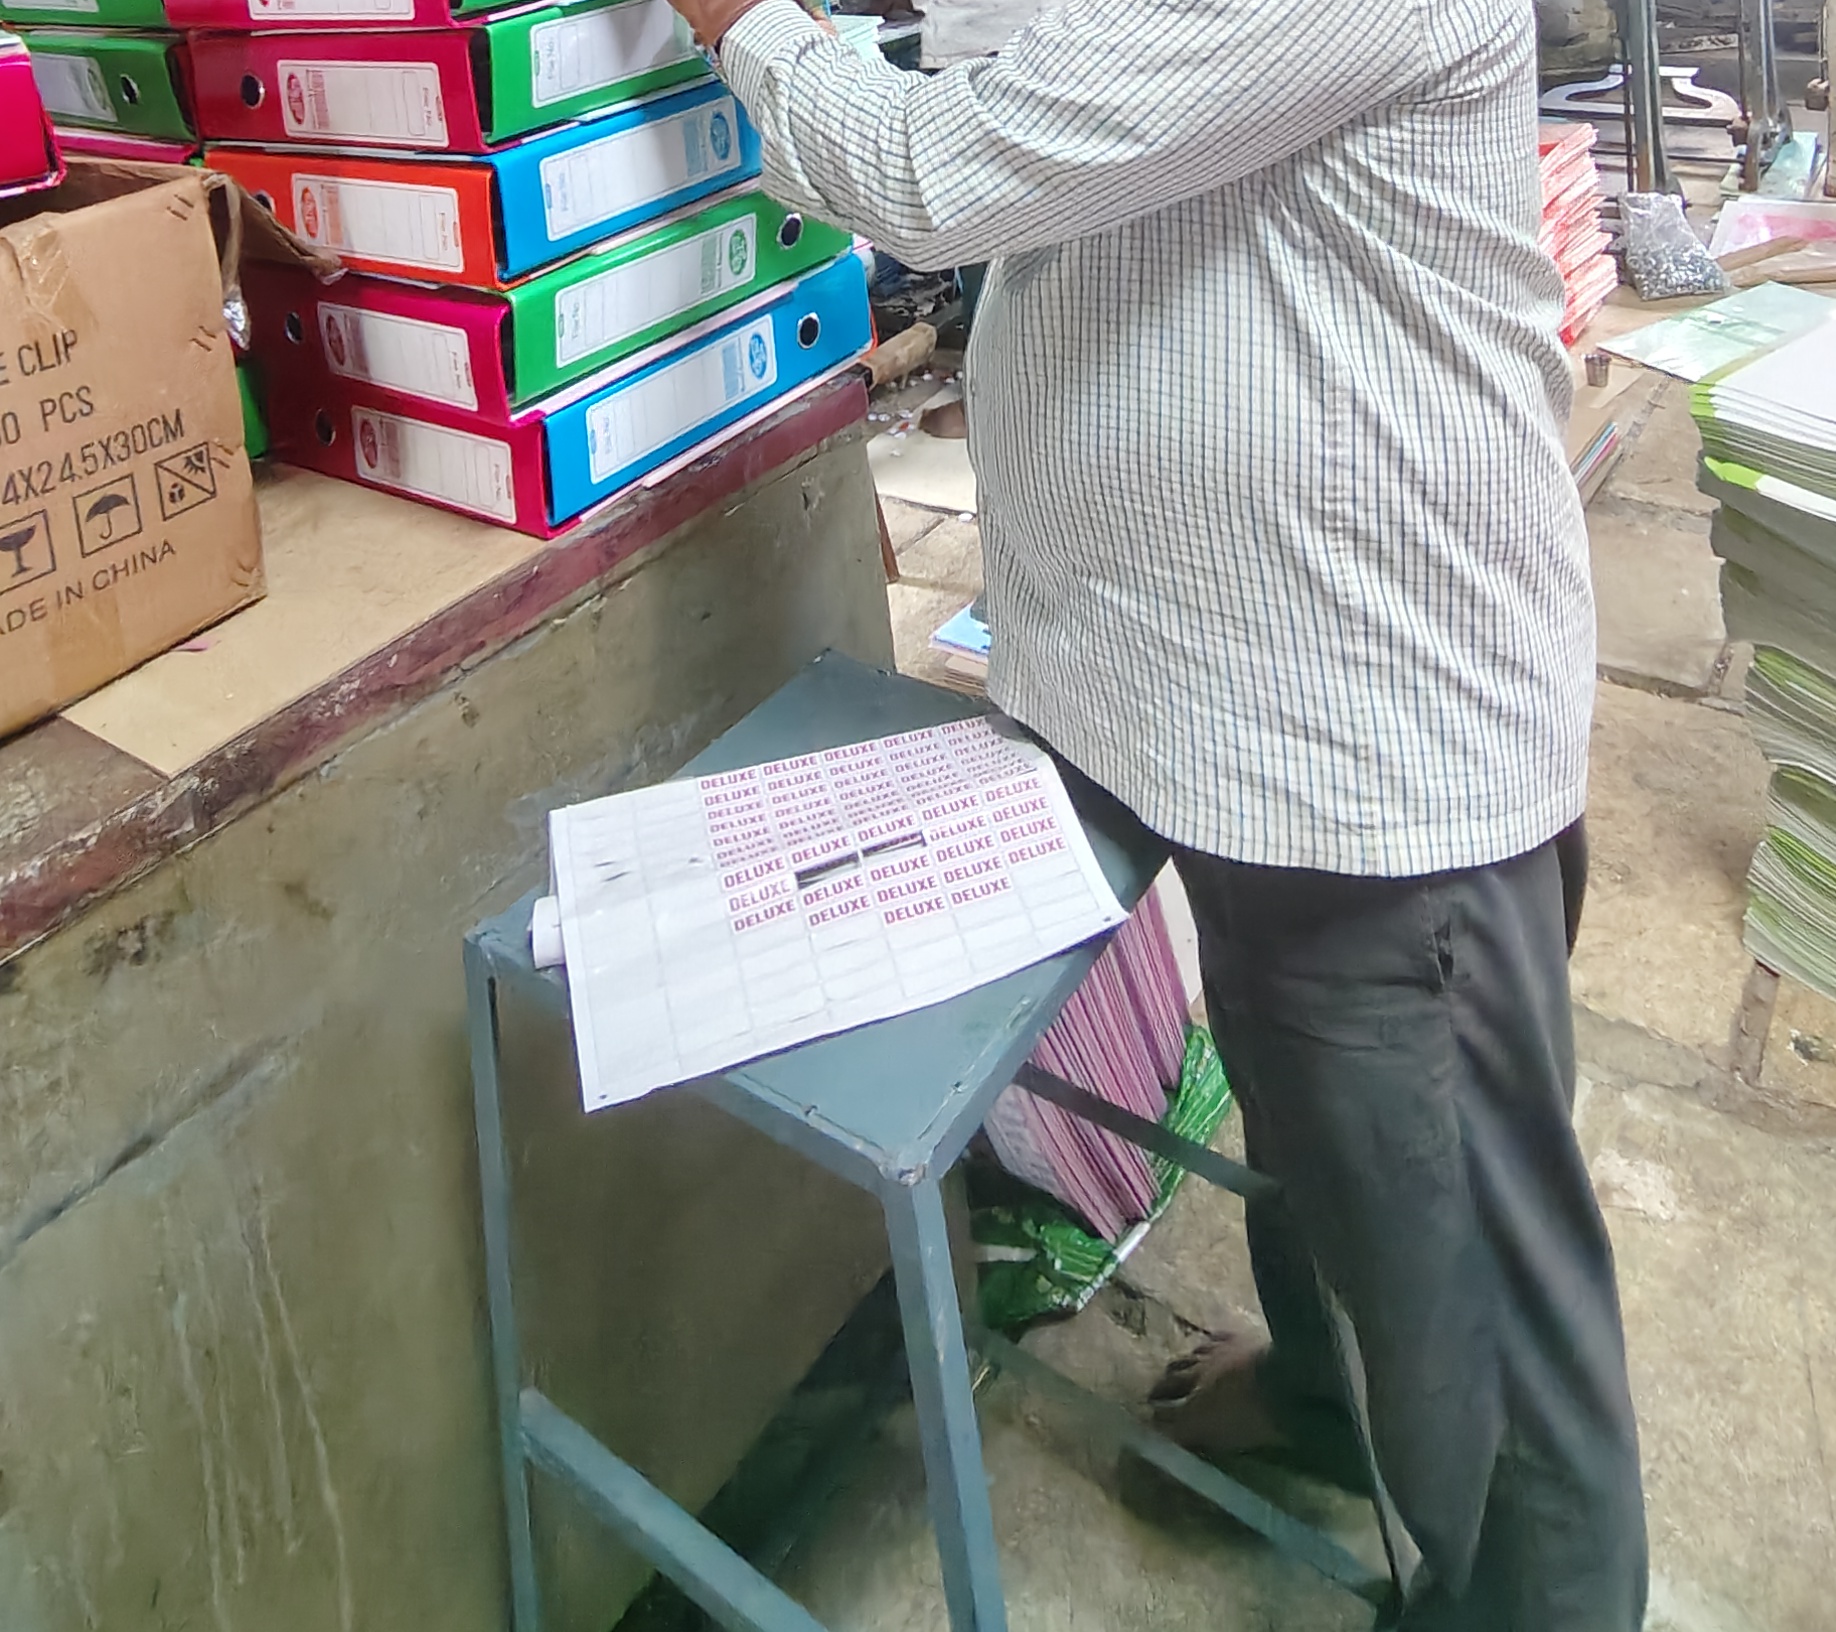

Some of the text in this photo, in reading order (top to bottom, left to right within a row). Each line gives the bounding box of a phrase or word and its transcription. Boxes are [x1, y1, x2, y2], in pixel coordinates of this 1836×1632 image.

[17, 328, 78, 376] CLIP
[0, 385, 94, 445] 0 PCS
[0, 539, 176, 635] DE IN CHINA
[701, 769, 757, 790] DELUXE
[764, 756, 818, 776] DELUXE
[824, 742, 878, 762] DELUXE
[884, 729, 934, 748] DELUXE
[704, 785, 760, 806] DELUXE
[768, 771, 822, 791] DELUXE
[830, 757, 881, 776] DELUXE
[890, 743, 940, 761] DELUXE
[708, 800, 764, 819] DELUXE
[772, 784, 827, 804] DELUXE
[834, 769, 887, 788] DELUXE
[710, 814, 766, 833] DELUXE
[775, 797, 831, 818] DELUXE
[840, 780, 893, 800] DELUXE
[713, 826, 771, 846] DELUXE
[779, 808, 836, 829] DELUXE
[724, 857, 785, 888] DELUXE
[792, 836, 851, 864] DELUXE
[858, 814, 915, 842] DELUXE
[922, 795, 979, 821] DELUXE
[985, 777, 1042, 802] DELUXE
[729, 797, 1049, 912] DELUXE DELUXE DELUXE
[734, 899, 796, 931] DELUXE
[803, 875, 864, 906] DELUXE
[870, 854, 930, 882] DELUXE
[936, 835, 995, 862] DELUXE
[1000, 816, 1057, 843] DELUXE
[809, 837, 1066, 926] DELUXE DELUXE DELUXE DELUXE
[884, 877, 1011, 925] DELUXE DELUXE
